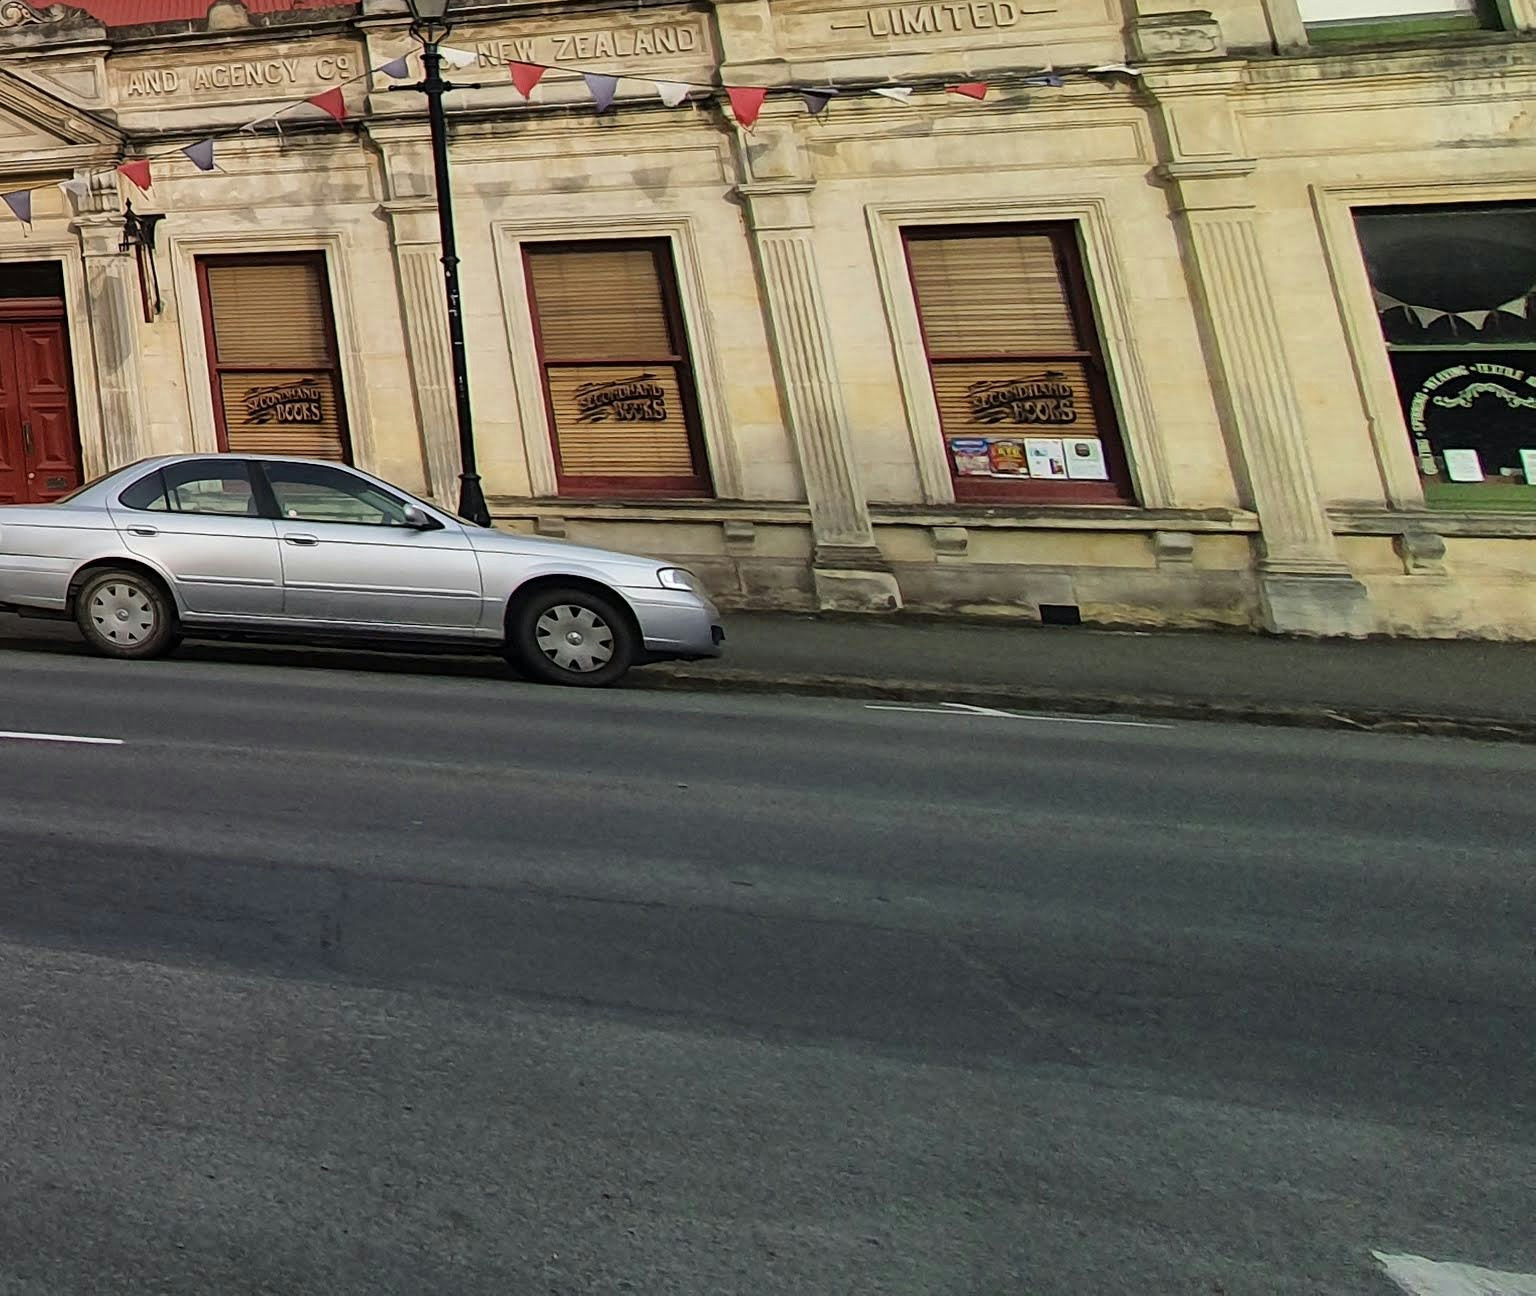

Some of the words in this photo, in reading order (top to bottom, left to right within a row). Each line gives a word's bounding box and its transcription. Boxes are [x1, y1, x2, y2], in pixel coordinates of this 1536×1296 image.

[867, 1, 1018, 37] LIMITED
[477, 39, 536, 68] NEW
[552, 25, 697, 61] ZEALAND
[128, 69, 179, 96] AND
[194, 59, 299, 90] AGENCY
[276, 402, 320, 422] BOOKS
